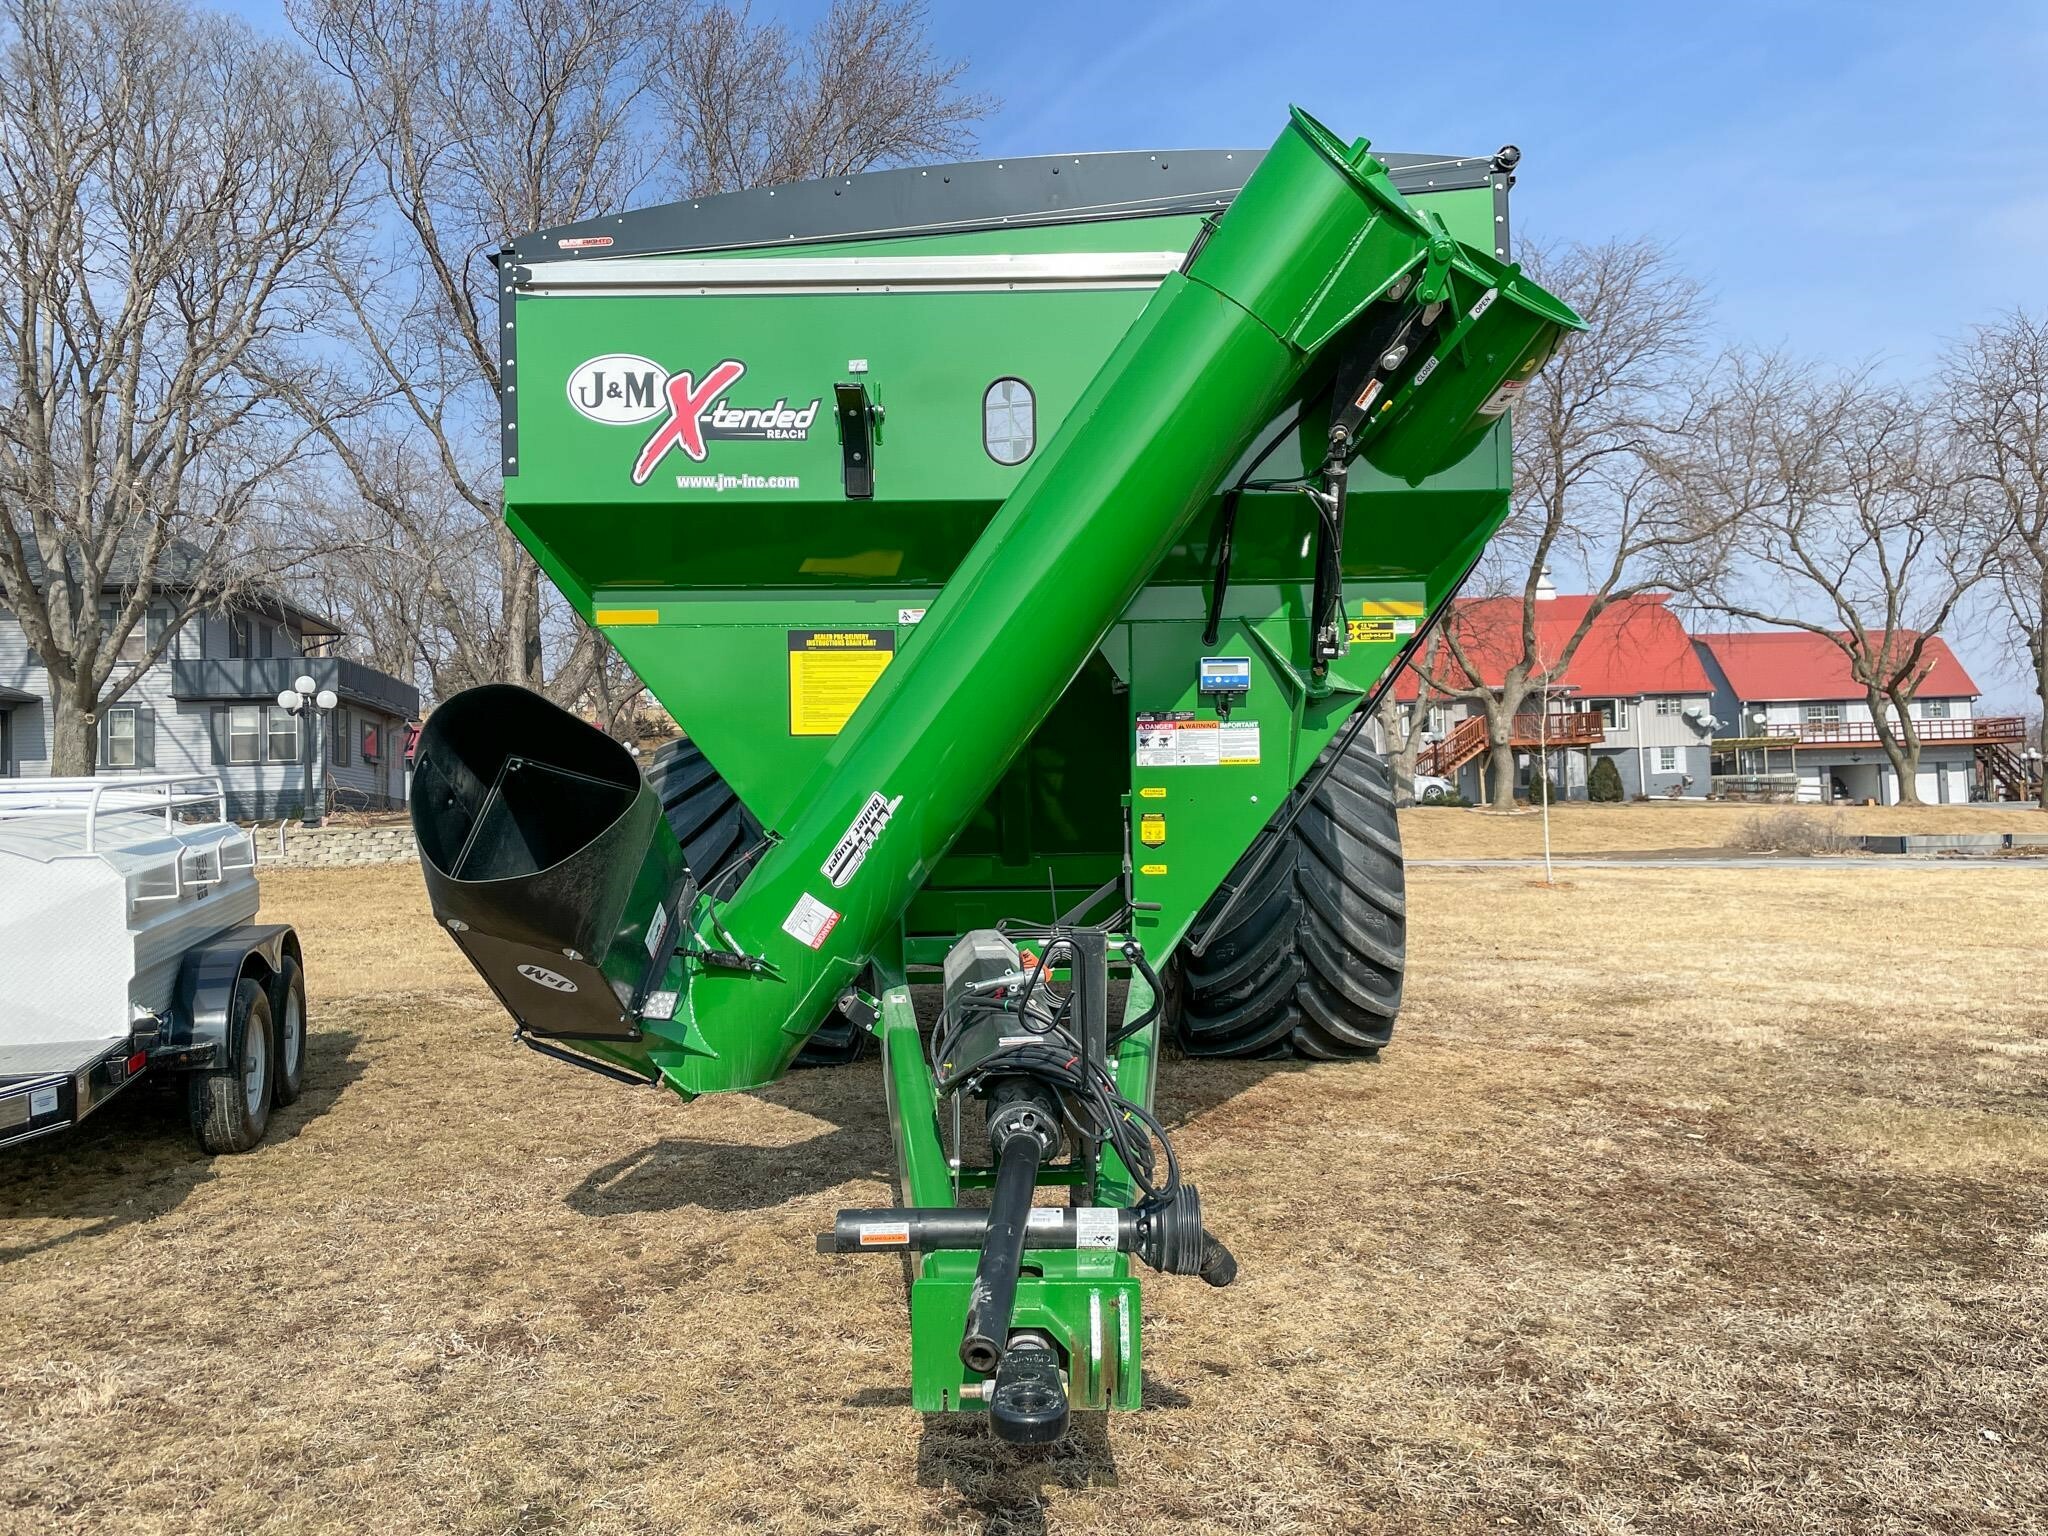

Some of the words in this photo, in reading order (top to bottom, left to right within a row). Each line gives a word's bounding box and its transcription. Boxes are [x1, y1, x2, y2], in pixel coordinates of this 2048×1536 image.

[1475, 295, 1491, 314] OPEN
[1416, 358, 1436, 382] CLOSED
[578, 371, 657, 408] J&M
[766, 429, 806, 439] REACH
[676, 473, 800, 492] www.jm-inc.com
[853, 798, 881, 836] Bullet
[827, 835, 854, 874] Auger
[812, 919, 836, 947] DANGER
[523, 966, 575, 990] J&M
